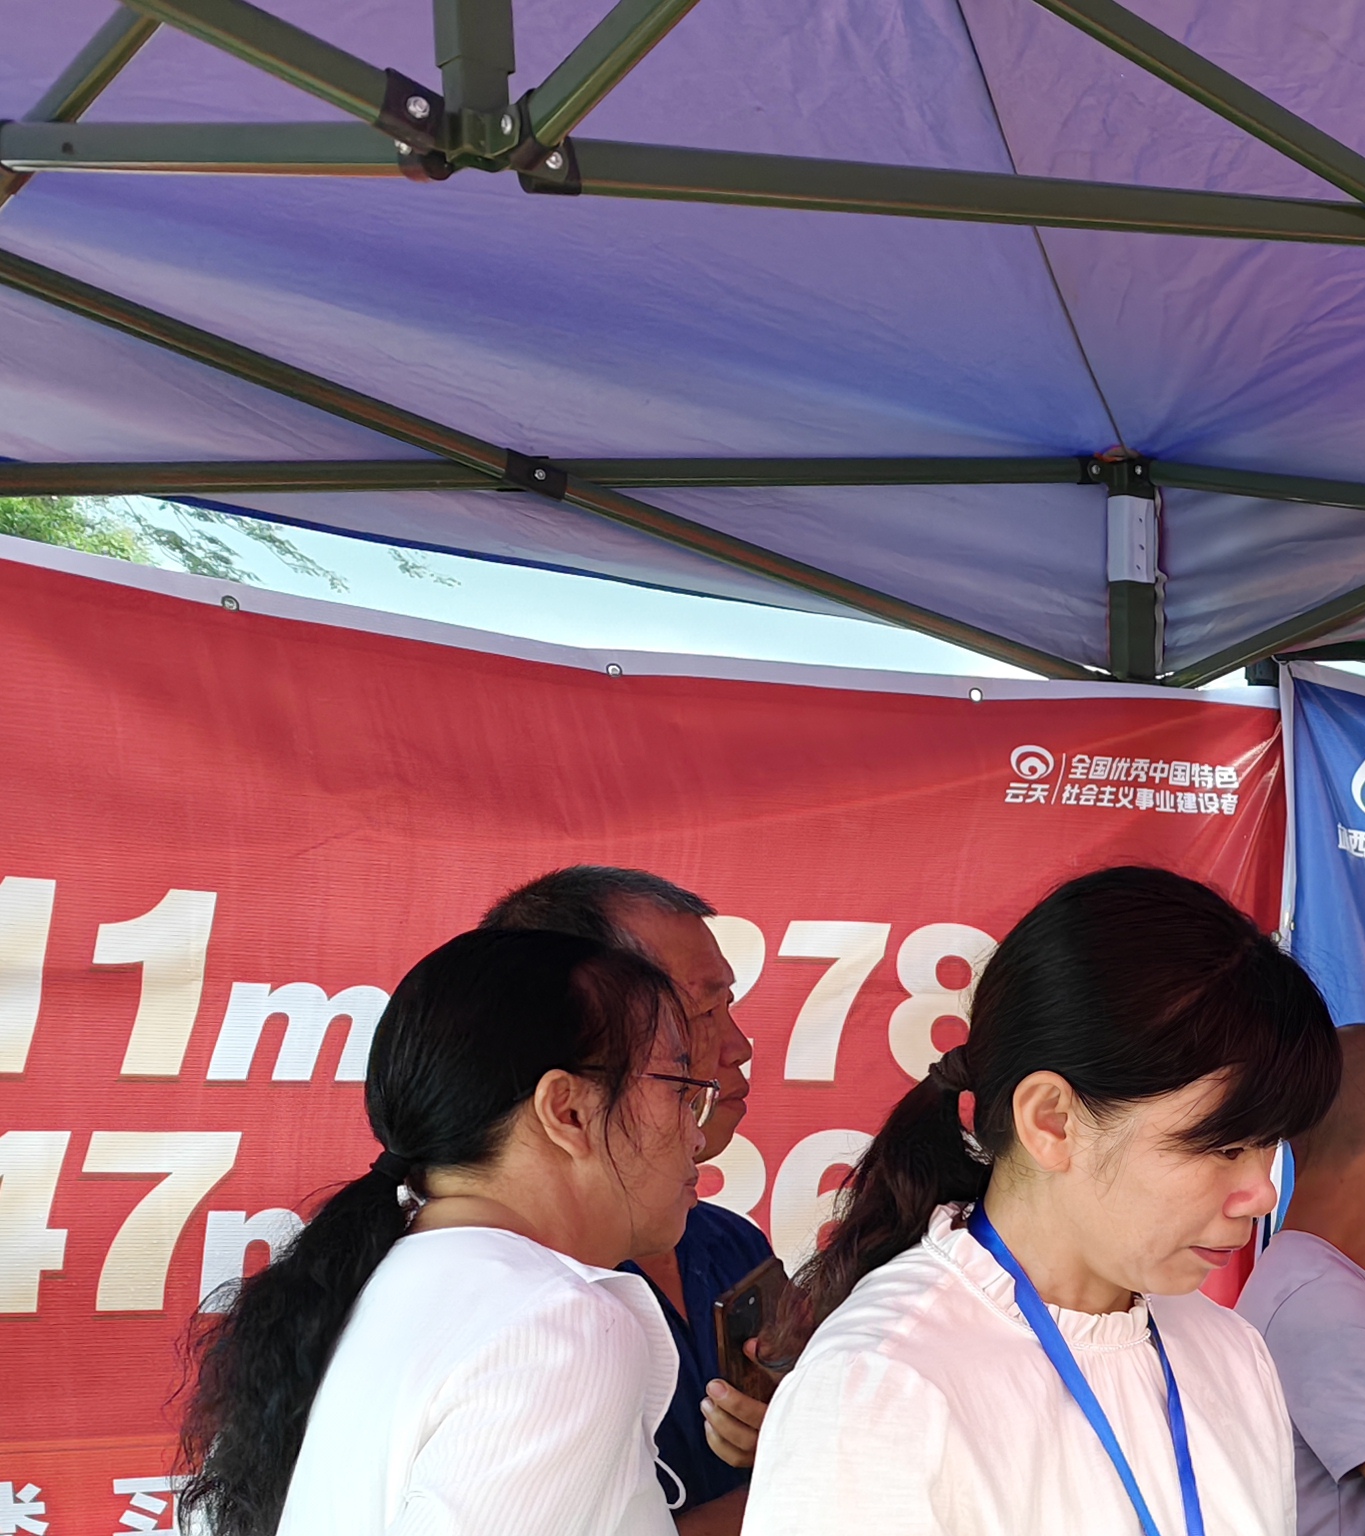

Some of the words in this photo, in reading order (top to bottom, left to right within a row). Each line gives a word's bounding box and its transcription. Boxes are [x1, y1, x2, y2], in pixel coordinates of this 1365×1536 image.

[1068, 754, 1240, 789] 全国优秀中国特色
[1004, 782, 1050, 804] 云天
[1061, 783, 1238, 815] 社会主义事业建设者
